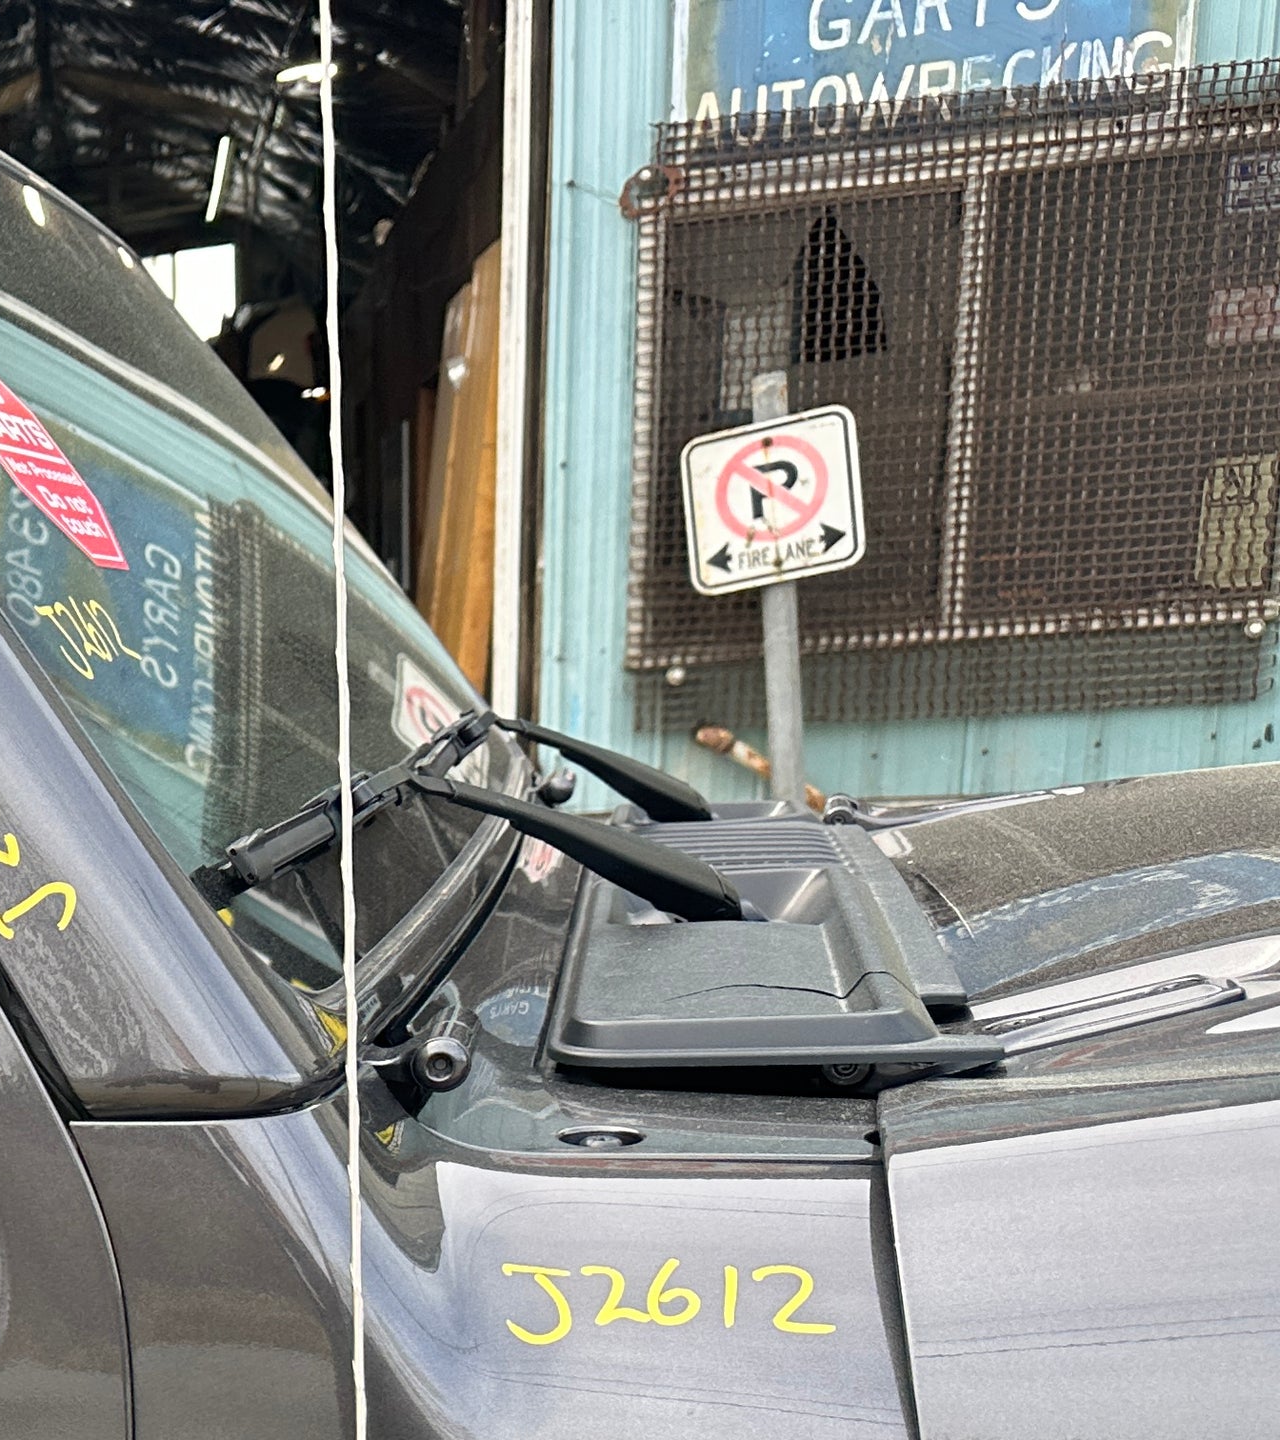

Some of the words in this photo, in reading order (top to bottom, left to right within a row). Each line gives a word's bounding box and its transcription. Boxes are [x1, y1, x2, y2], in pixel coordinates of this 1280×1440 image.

[690, 30, 1174, 148] AUTOWRECKING
[36, 485, 67, 510] Do
[61, 514, 108, 538] touch
[738, 546, 770, 569] FIRE
[502, 1258, 837, 1345] J2612
